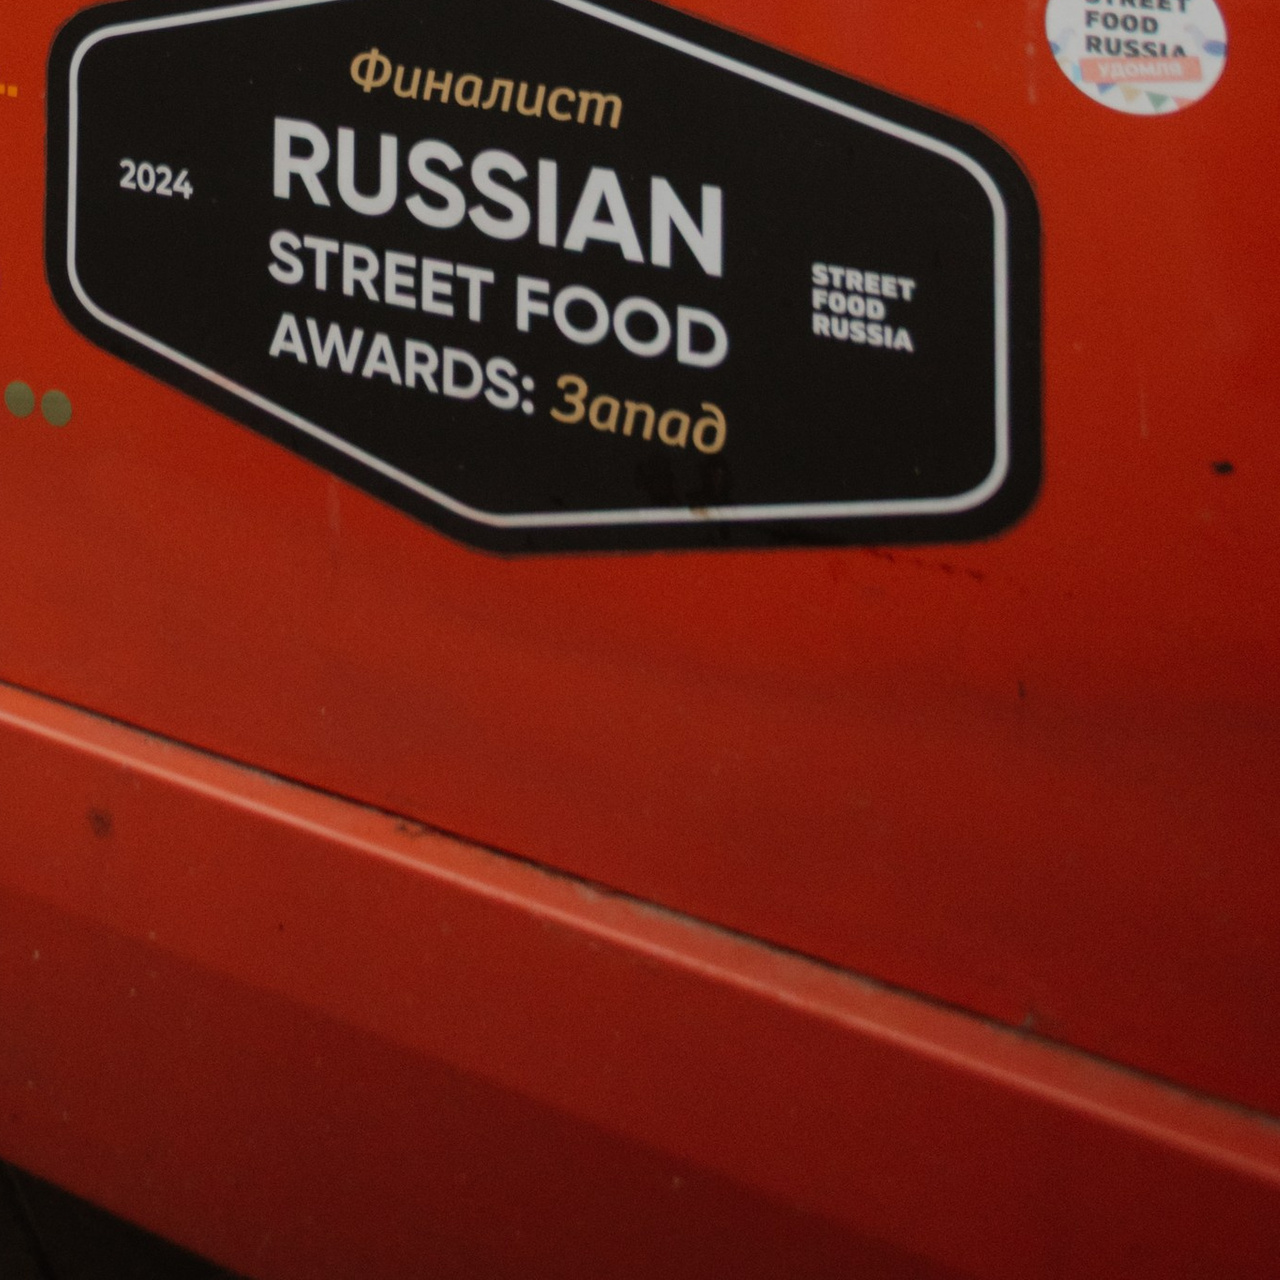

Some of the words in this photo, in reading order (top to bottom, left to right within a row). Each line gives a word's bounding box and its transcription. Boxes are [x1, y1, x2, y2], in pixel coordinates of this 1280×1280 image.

[1085, 9, 1159, 35] FOOD
[1085, 34, 1187, 58] RUSSIA
[349, 47, 624, 129] Финалист
[1097, 59, 1184, 78] УДОМЛЯ
[119, 158, 194, 200] 2024
[273, 115, 724, 278] RUSSIAN
[268, 230, 494, 322] STREET
[517, 276, 729, 368] FOOD
[812, 263, 916, 301] STREET
[812, 288, 887, 321] FOOD
[812, 313, 913, 352] RUSSIA
[268, 312, 536, 415] AWARDS:
[550, 373, 728, 455] Запад
